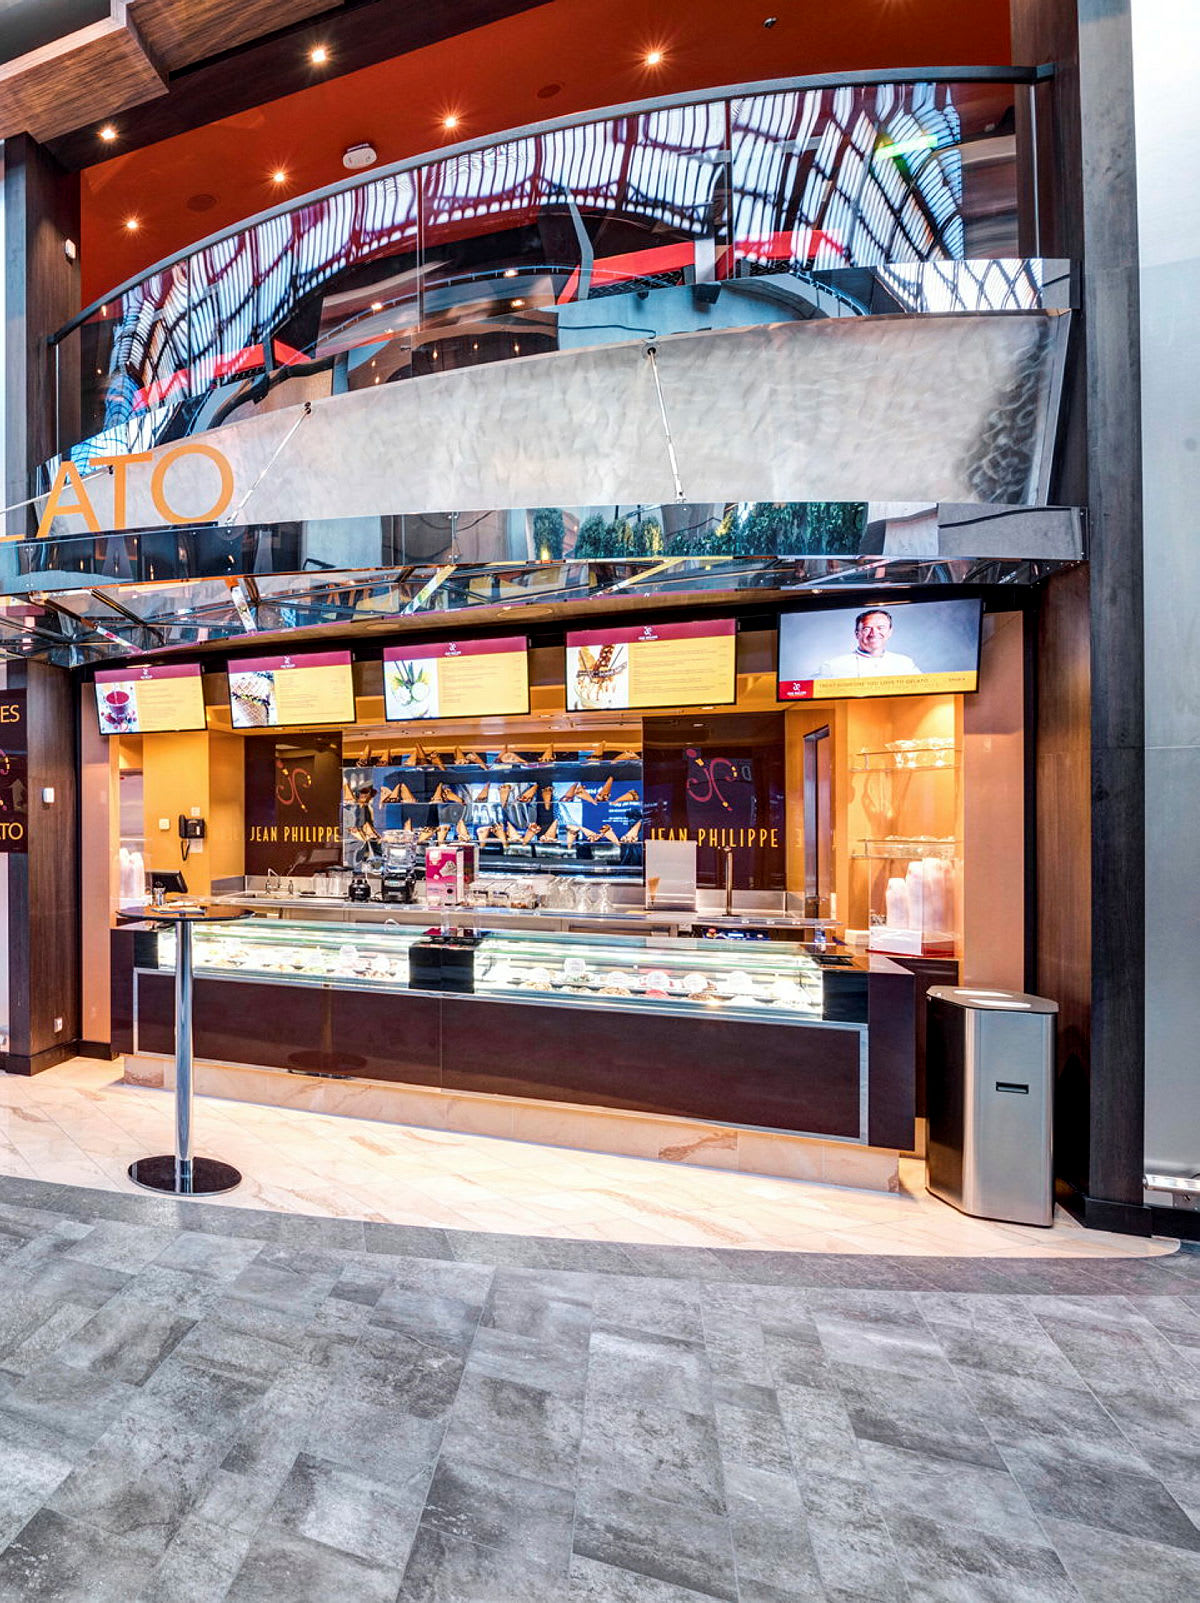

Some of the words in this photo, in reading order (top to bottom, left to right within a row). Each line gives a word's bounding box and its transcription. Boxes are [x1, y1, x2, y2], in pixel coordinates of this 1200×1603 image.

[249, 826, 277, 842] JEAN
[283, 826, 341, 842] PHILIPPE
[650, 828, 688, 841] JEAN
[698, 828, 779, 848] PHILIPPE
